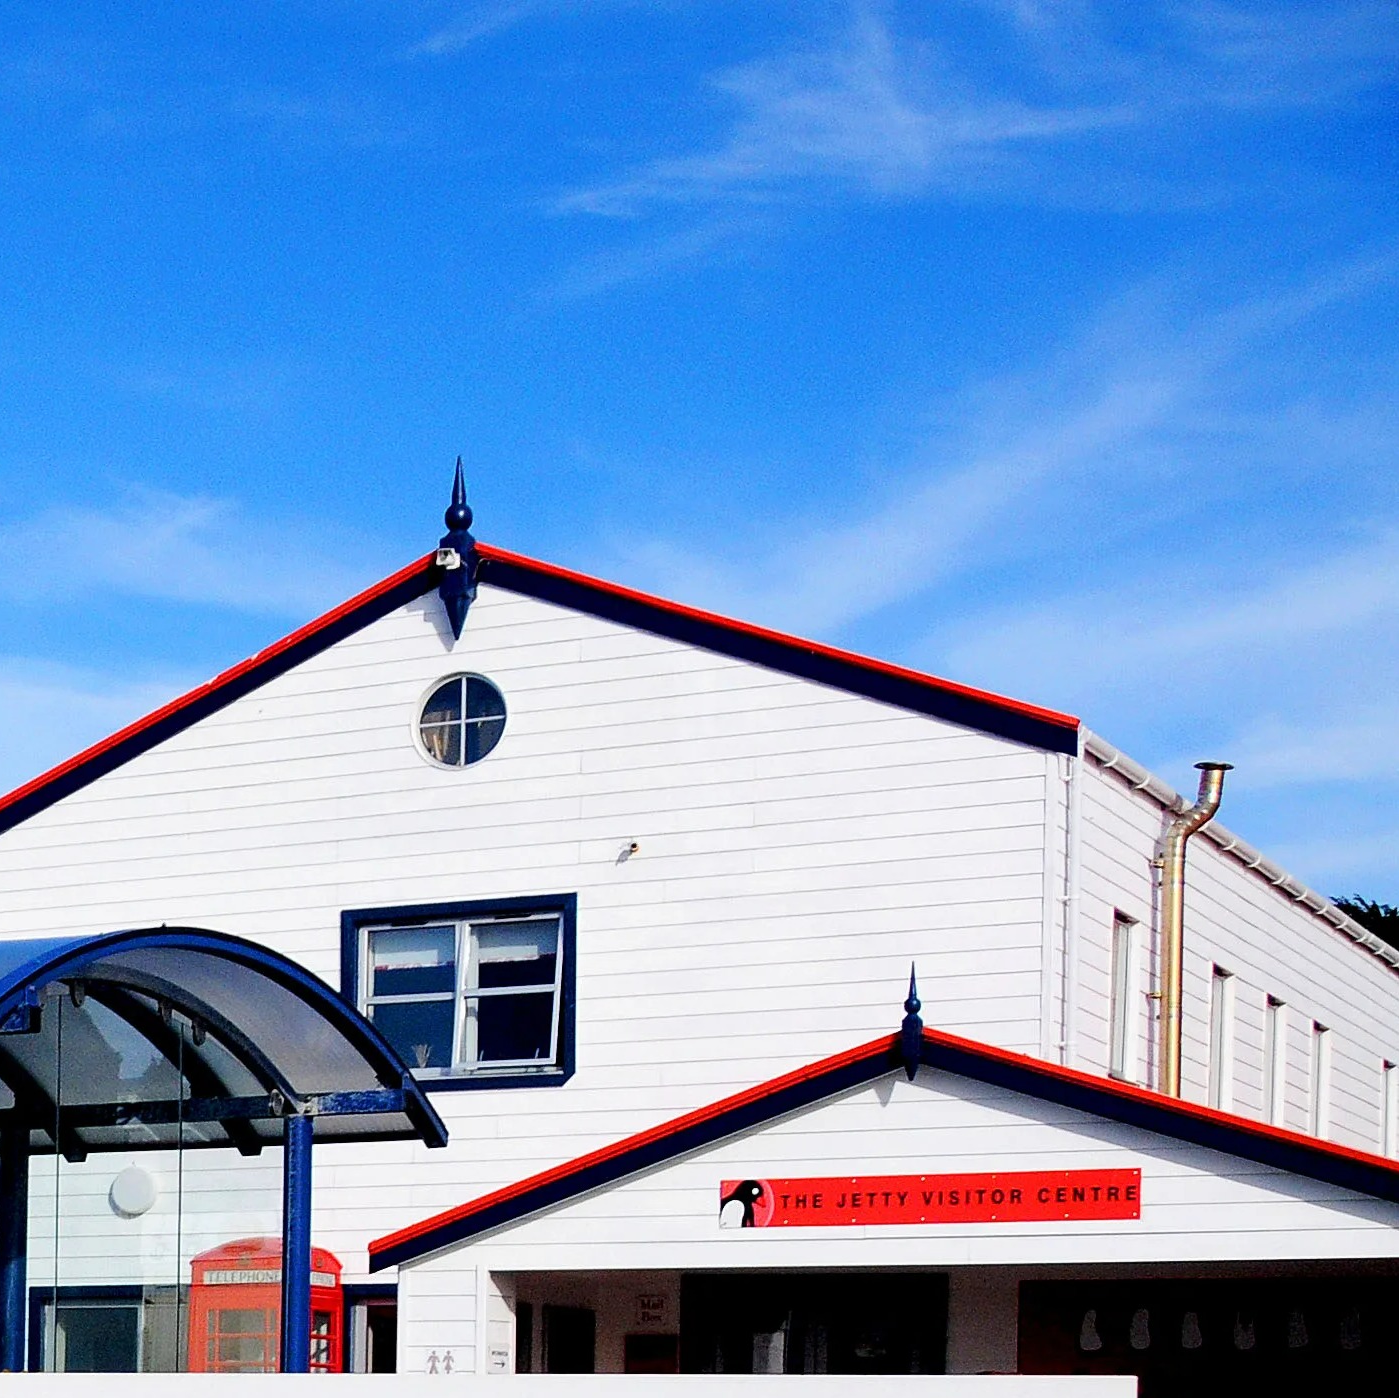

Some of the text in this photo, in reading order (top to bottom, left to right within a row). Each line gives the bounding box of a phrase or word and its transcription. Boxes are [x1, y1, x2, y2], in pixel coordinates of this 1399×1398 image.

[779, 1185, 1138, 1209] THE JETTY VISITOR CENTRE
[208, 1270, 280, 1283] TELEPHONE
